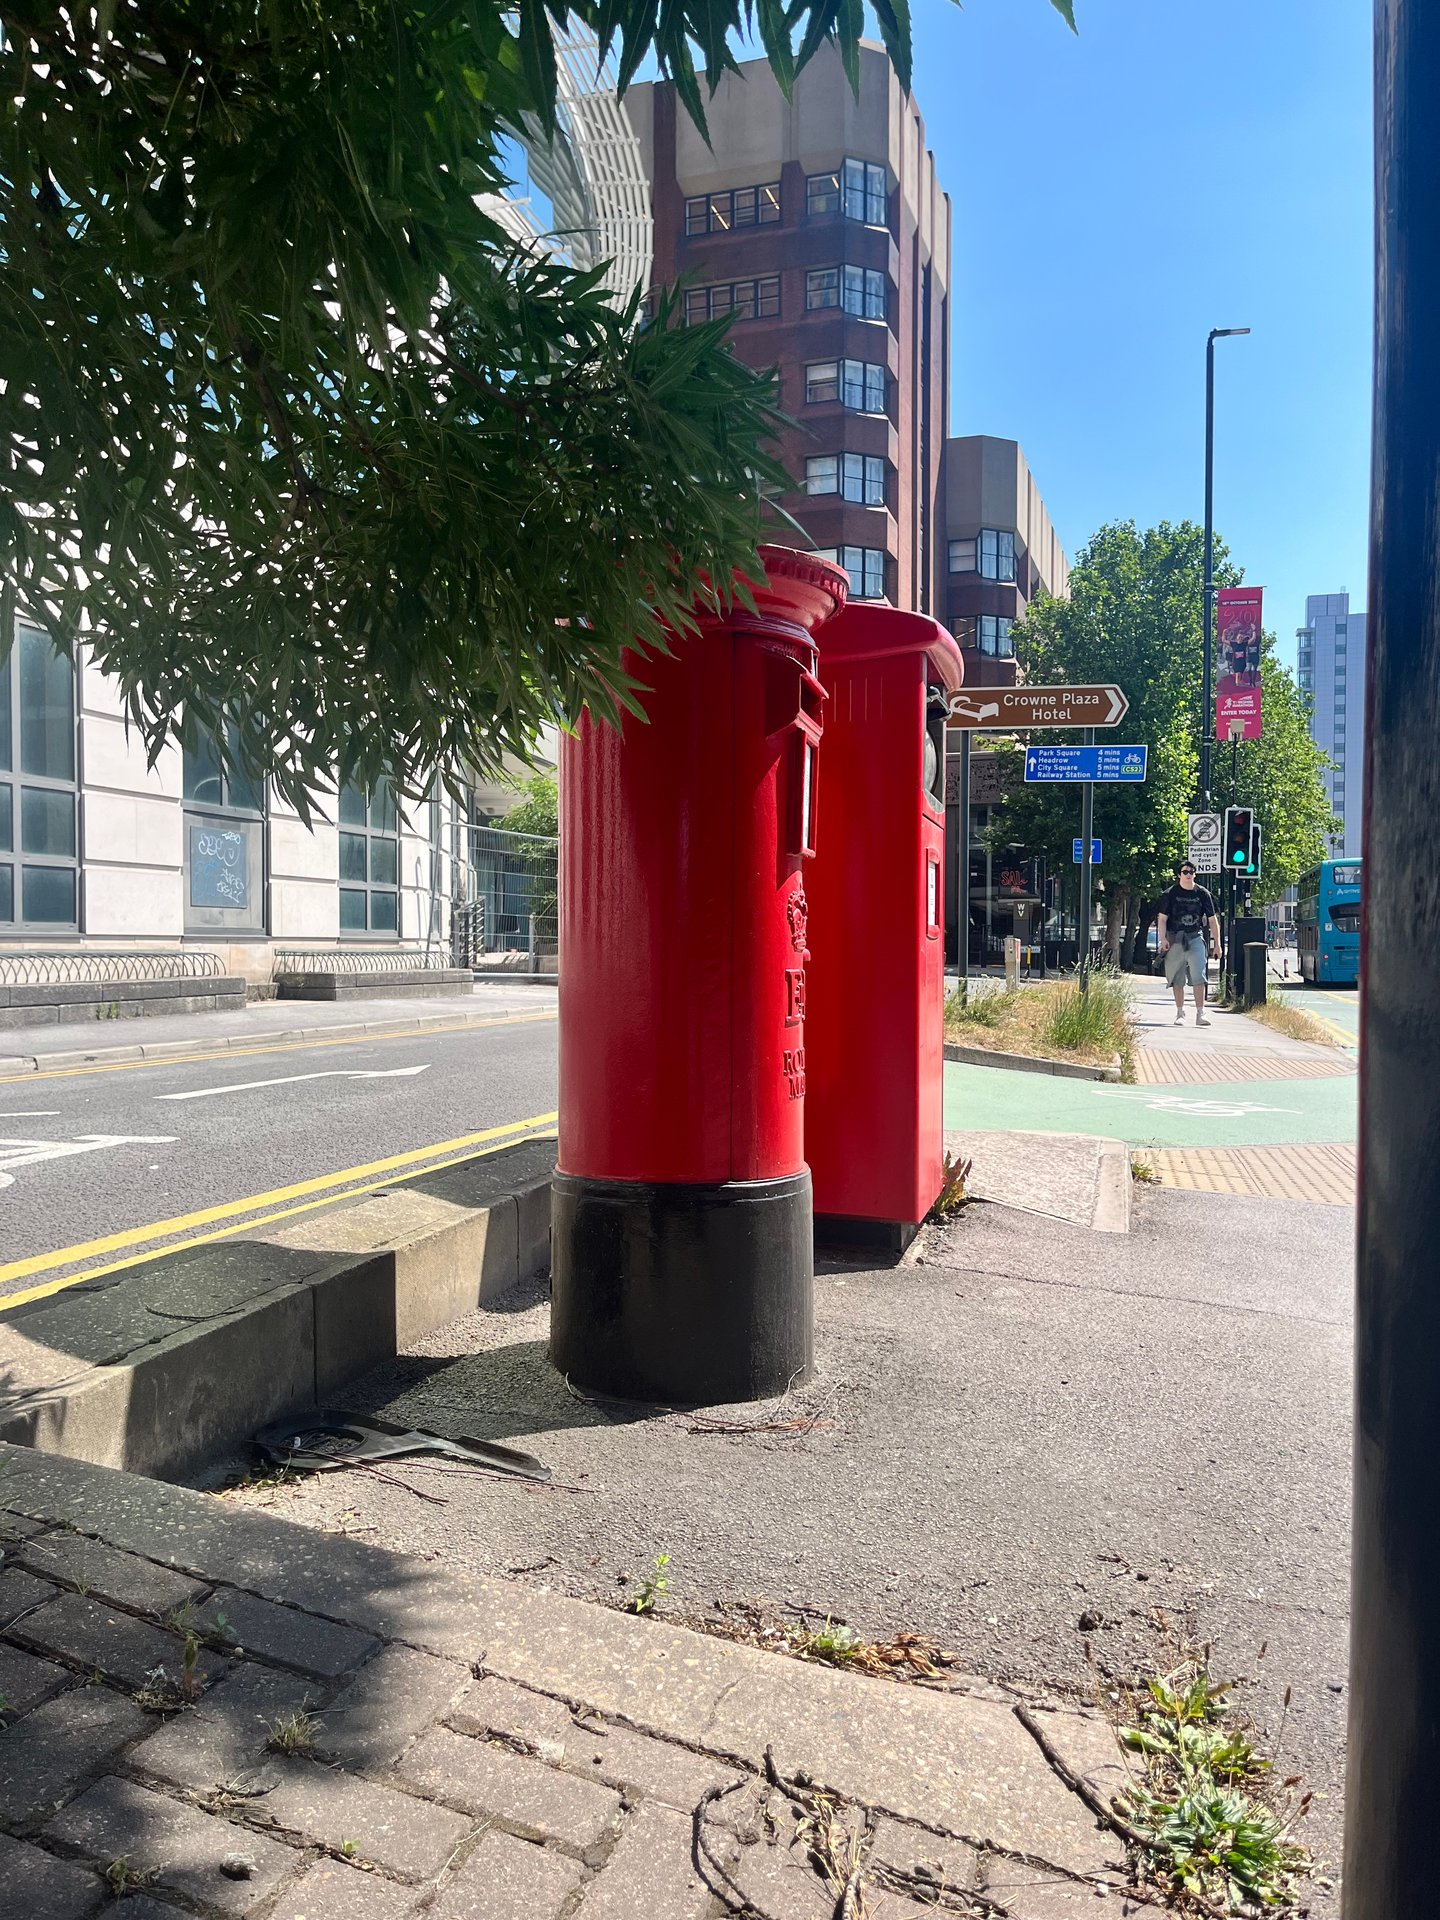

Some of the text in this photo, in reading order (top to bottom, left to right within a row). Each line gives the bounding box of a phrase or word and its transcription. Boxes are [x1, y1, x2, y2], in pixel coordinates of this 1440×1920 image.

[1003, 693, 1099, 706] Crowne Plaza
[1032, 708, 1072, 720] Hotel
